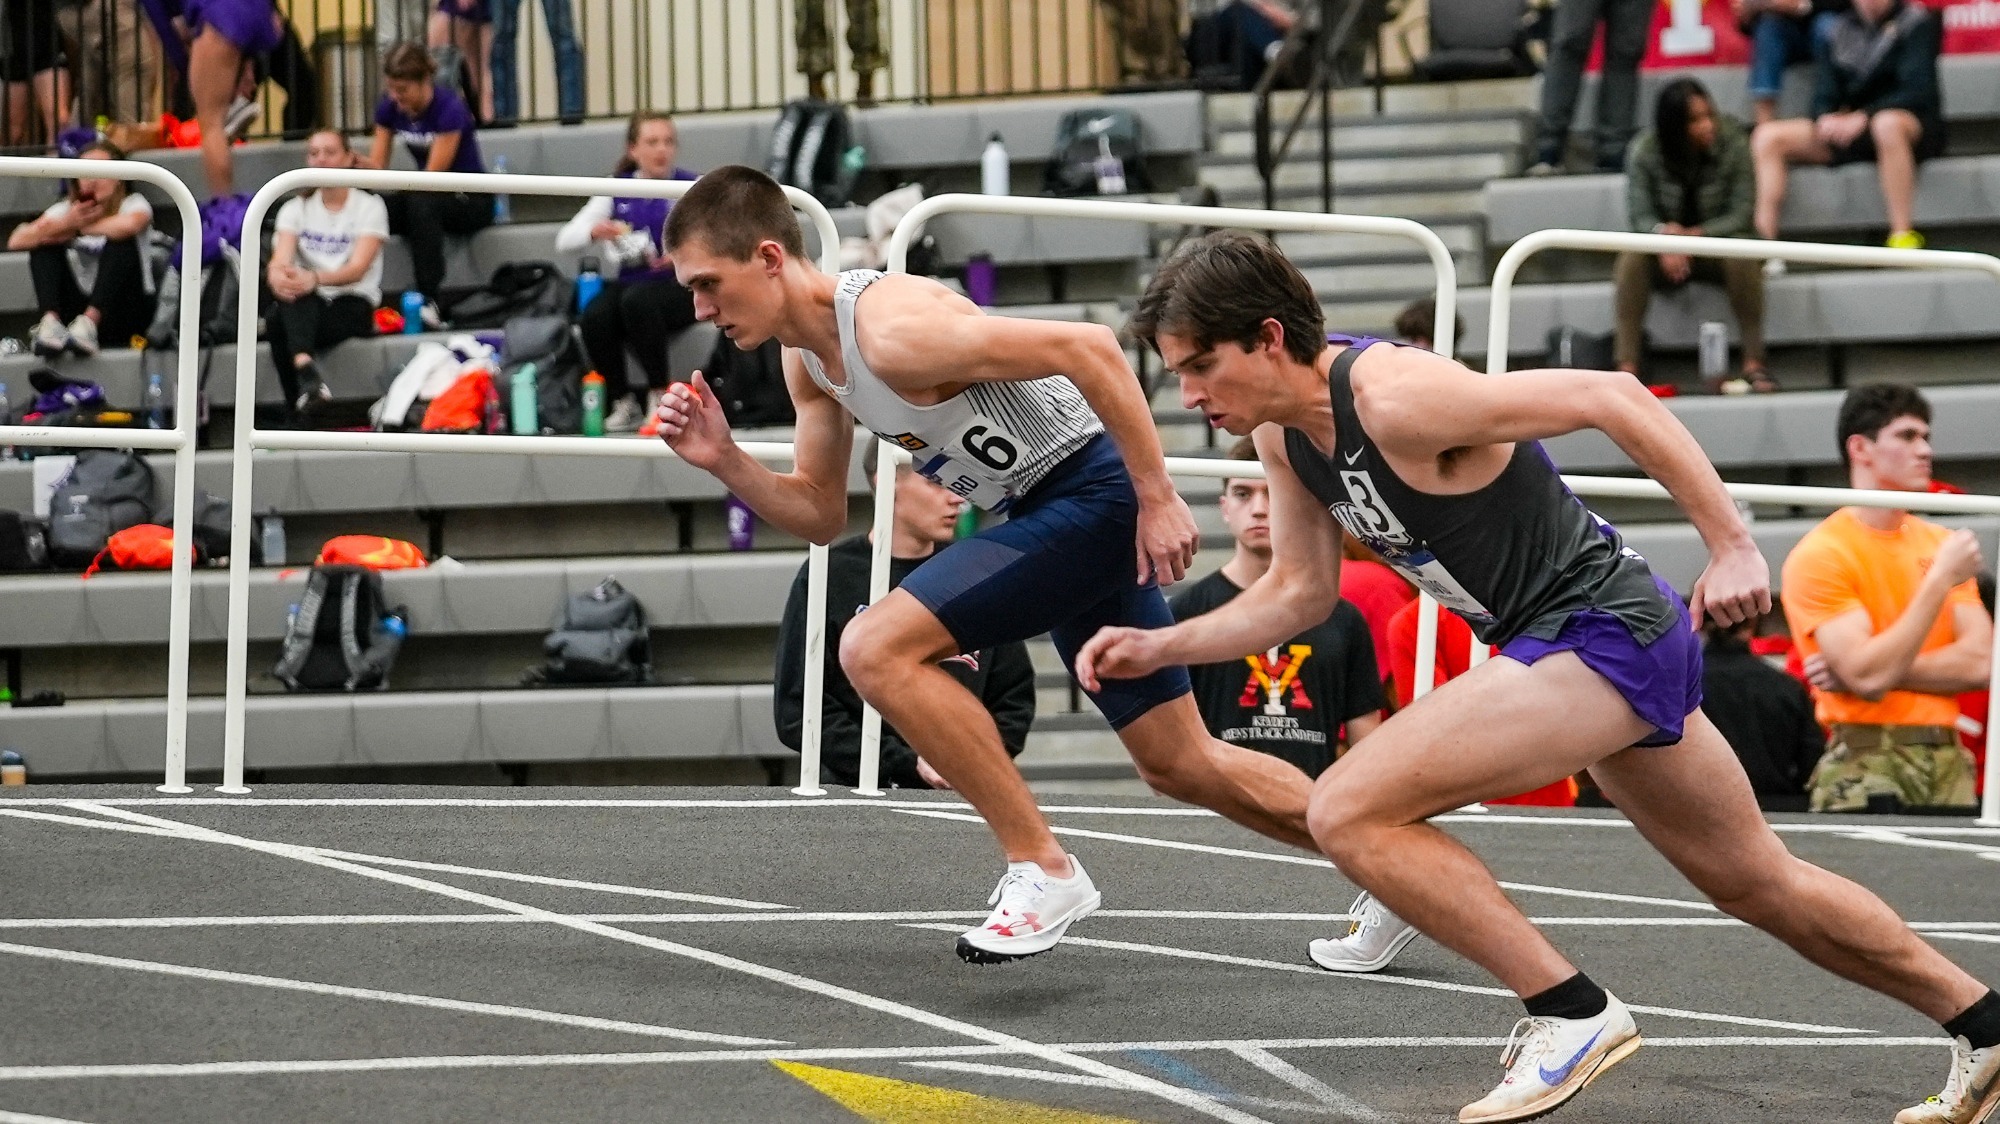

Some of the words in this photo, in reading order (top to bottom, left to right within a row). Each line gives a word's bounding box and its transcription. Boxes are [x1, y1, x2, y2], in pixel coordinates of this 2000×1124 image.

[962, 425, 1017, 471] 6
[1348, 475, 1390, 533] 3
[1248, 727, 1285, 741] TRACK
[1284, 728, 1308, 742] AND
